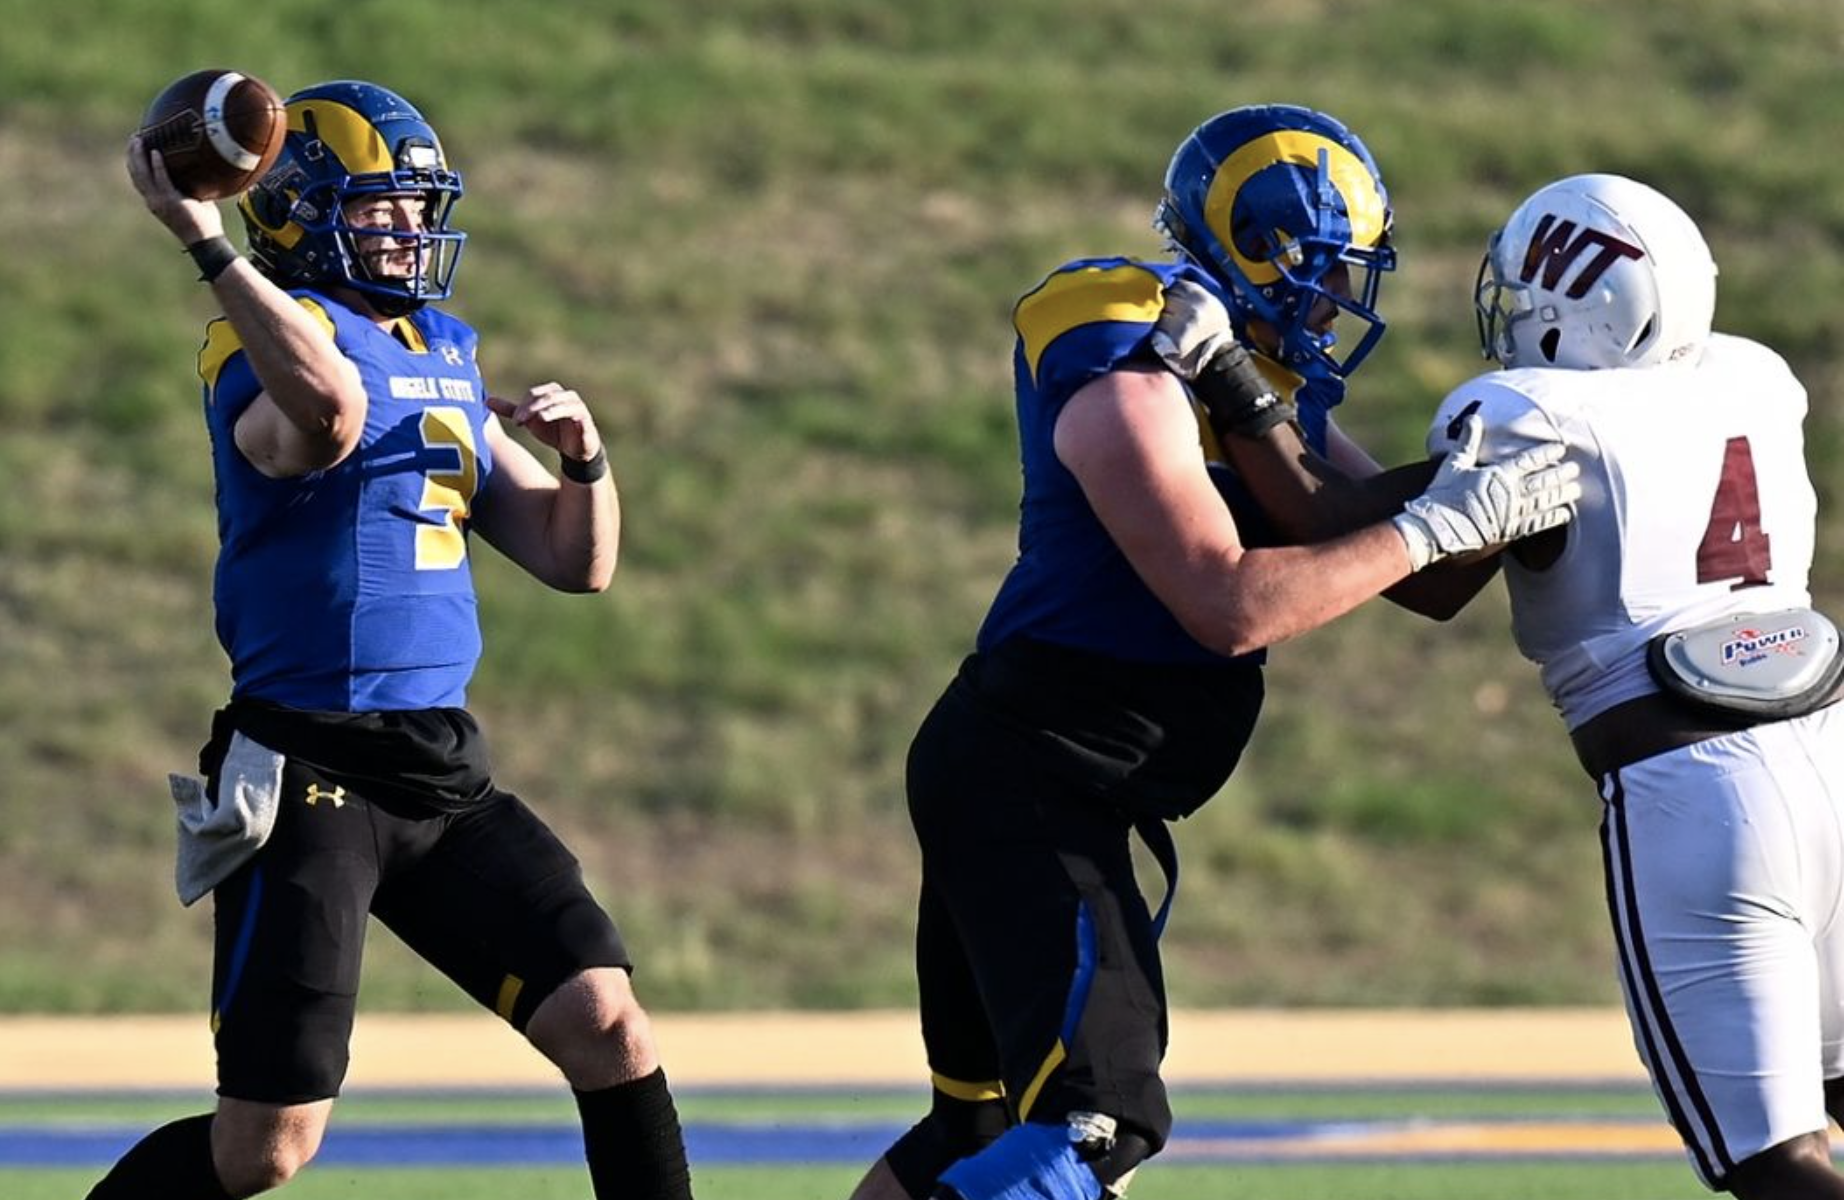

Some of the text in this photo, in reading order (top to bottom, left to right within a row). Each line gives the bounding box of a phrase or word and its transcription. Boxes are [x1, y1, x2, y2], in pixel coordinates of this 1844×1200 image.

[1519, 213, 1645, 300] WT
[414, 405, 478, 571] 3
[1696, 435, 1774, 592] 4
